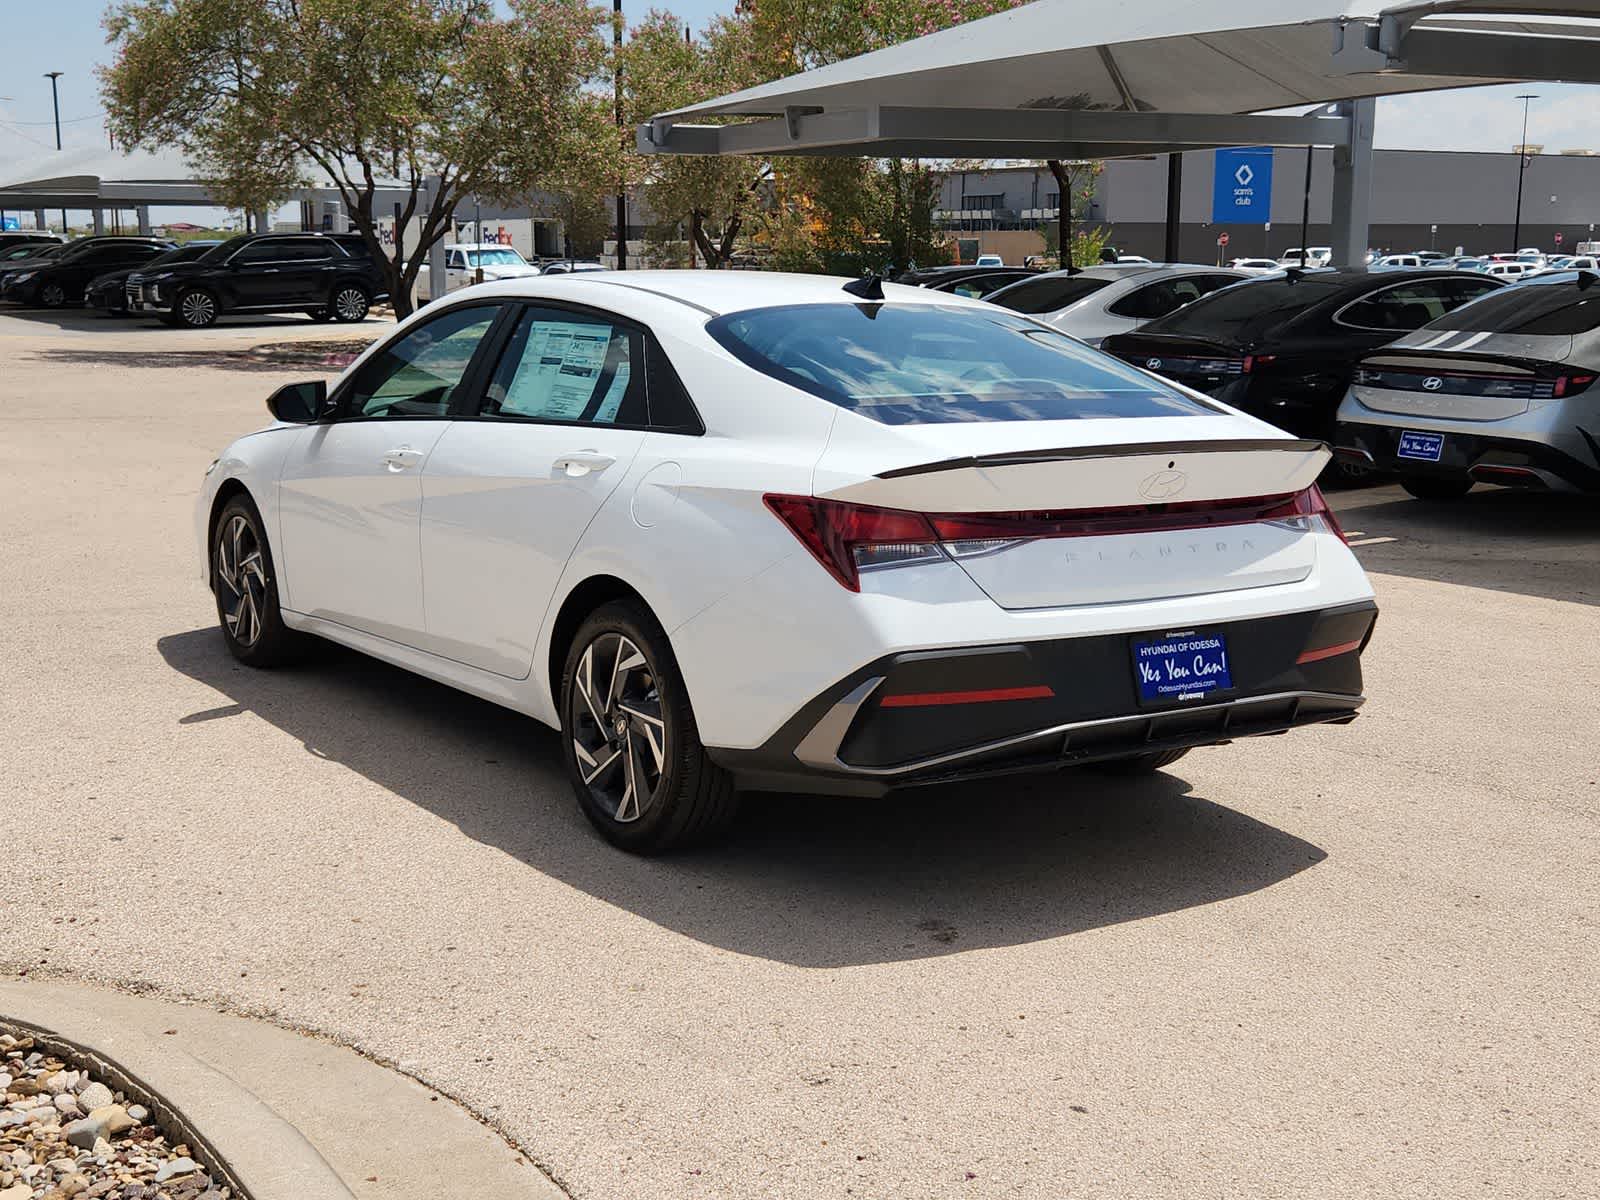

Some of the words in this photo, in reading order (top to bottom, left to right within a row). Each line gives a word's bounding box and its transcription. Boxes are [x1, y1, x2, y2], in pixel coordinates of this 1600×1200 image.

[1235, 196, 1252, 206] club
[483, 226, 513, 246] FedEx
[1140, 644, 1178, 657] HYUNDAI
[1178, 642, 1189, 652] OF
[1189, 639, 1221, 650] ODESSA
[1139, 661, 1161, 683] Yes
[1164, 658, 1191, 680] You
[1193, 651, 1227, 676] Can!
